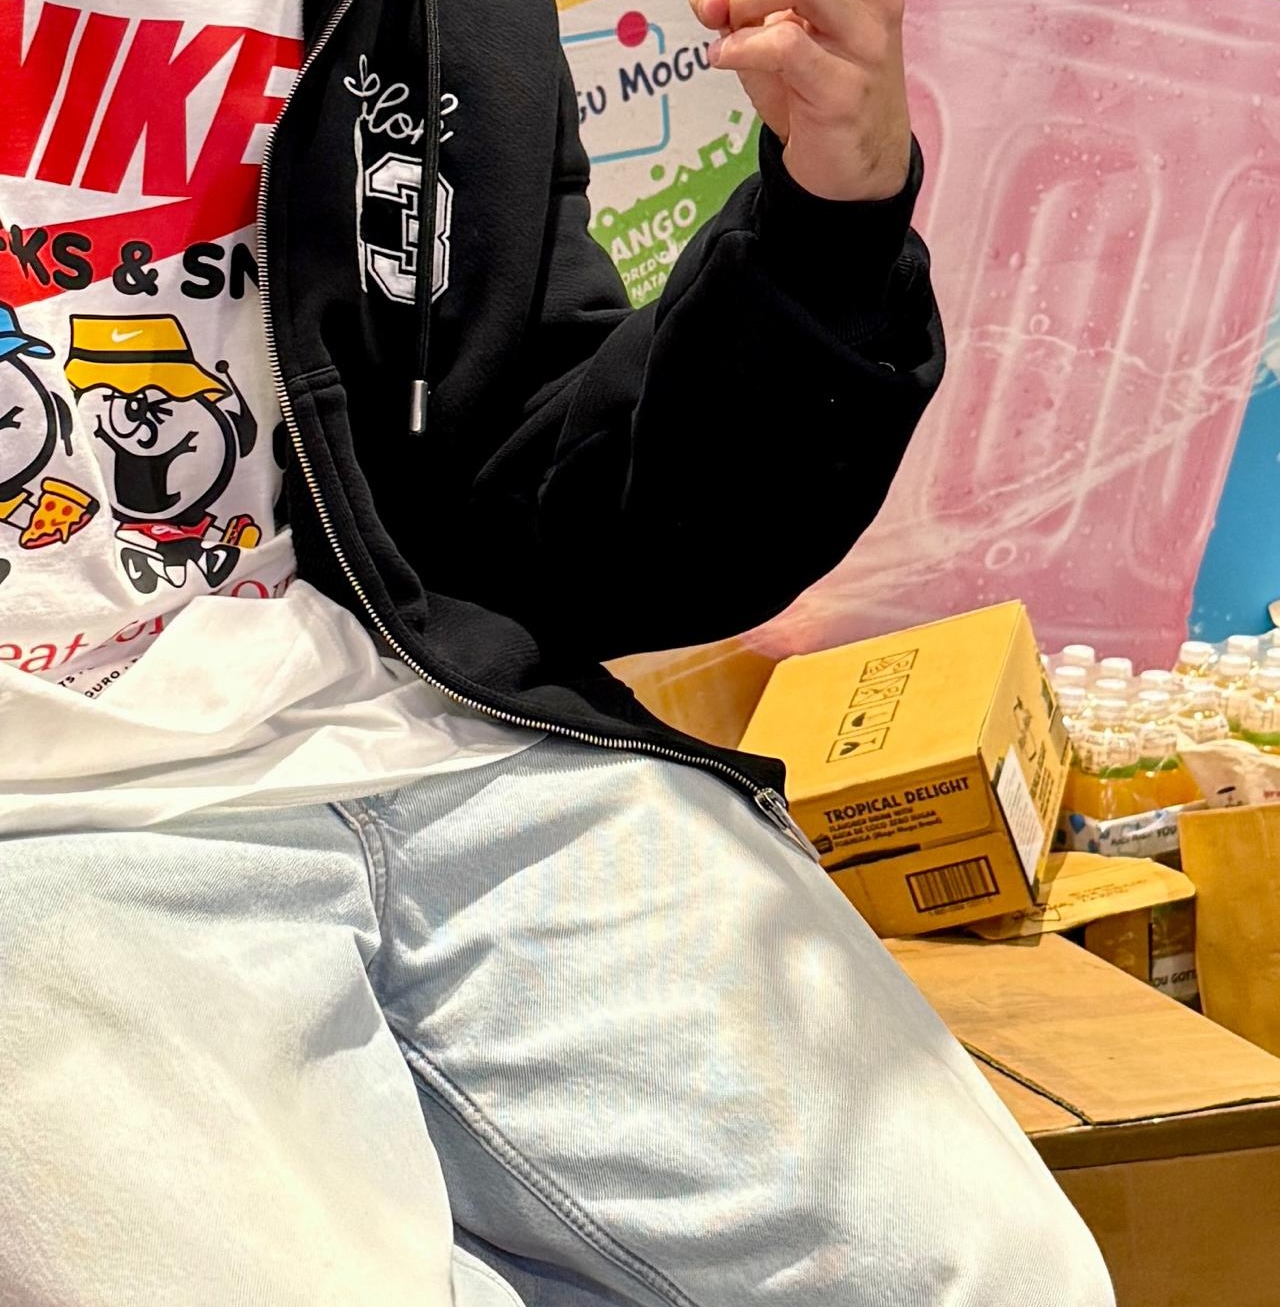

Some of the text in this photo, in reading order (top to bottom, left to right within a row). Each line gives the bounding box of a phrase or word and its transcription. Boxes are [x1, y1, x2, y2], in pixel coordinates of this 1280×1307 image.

[610, 199, 697, 264] ANGO
[112, 240, 158, 296] &
[824, 777, 970, 823] TROPICAL DELIGHT
